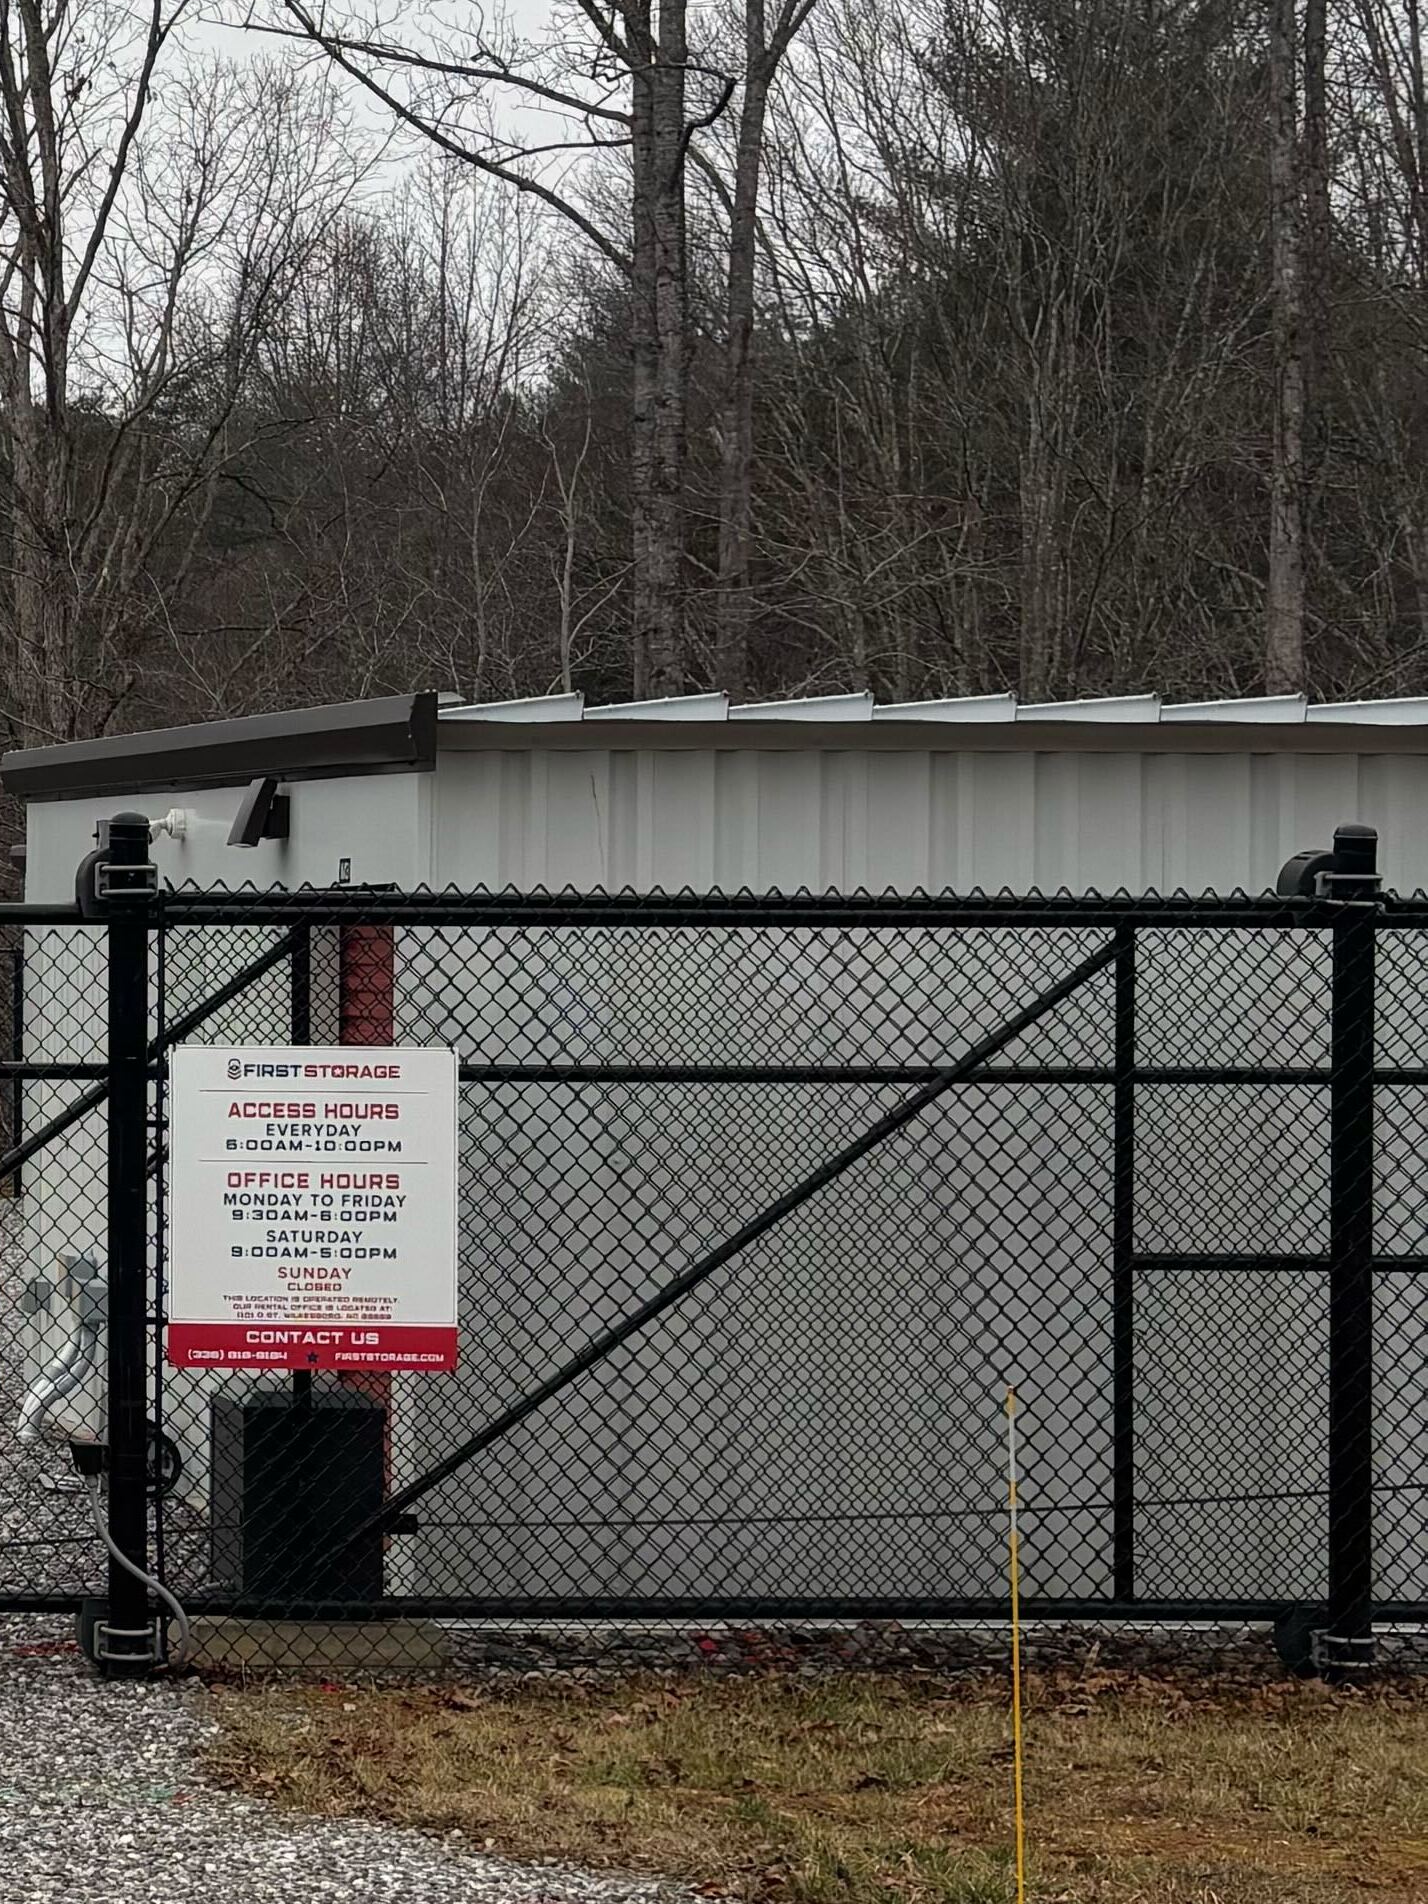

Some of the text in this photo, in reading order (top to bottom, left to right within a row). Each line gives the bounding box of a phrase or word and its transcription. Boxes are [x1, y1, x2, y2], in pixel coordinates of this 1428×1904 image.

[228, 1102, 400, 1120] ACCESS HOURS
[266, 1124, 362, 1137] EVERYDAY
[226, 1139, 402, 1152] 6:00AM-10:00PM
[227, 1172, 400, 1190] OFFICE HOURS
[223, 1193, 407, 1208] MONDAY TO FRIDAY
[232, 1210, 397, 1223] 9:30AM-6:00PM
[266, 1230, 363, 1243] SATURDAY
[231, 1246, 397, 1259] 9:00AM-5:00PM
[277, 1267, 352, 1280] SUNDAY
[287, 1283, 342, 1292] CLOSED
[246, 1331, 380, 1344] CONTACT US
[335, 1352, 444, 1362] FIRSTSTORAGE.COM
